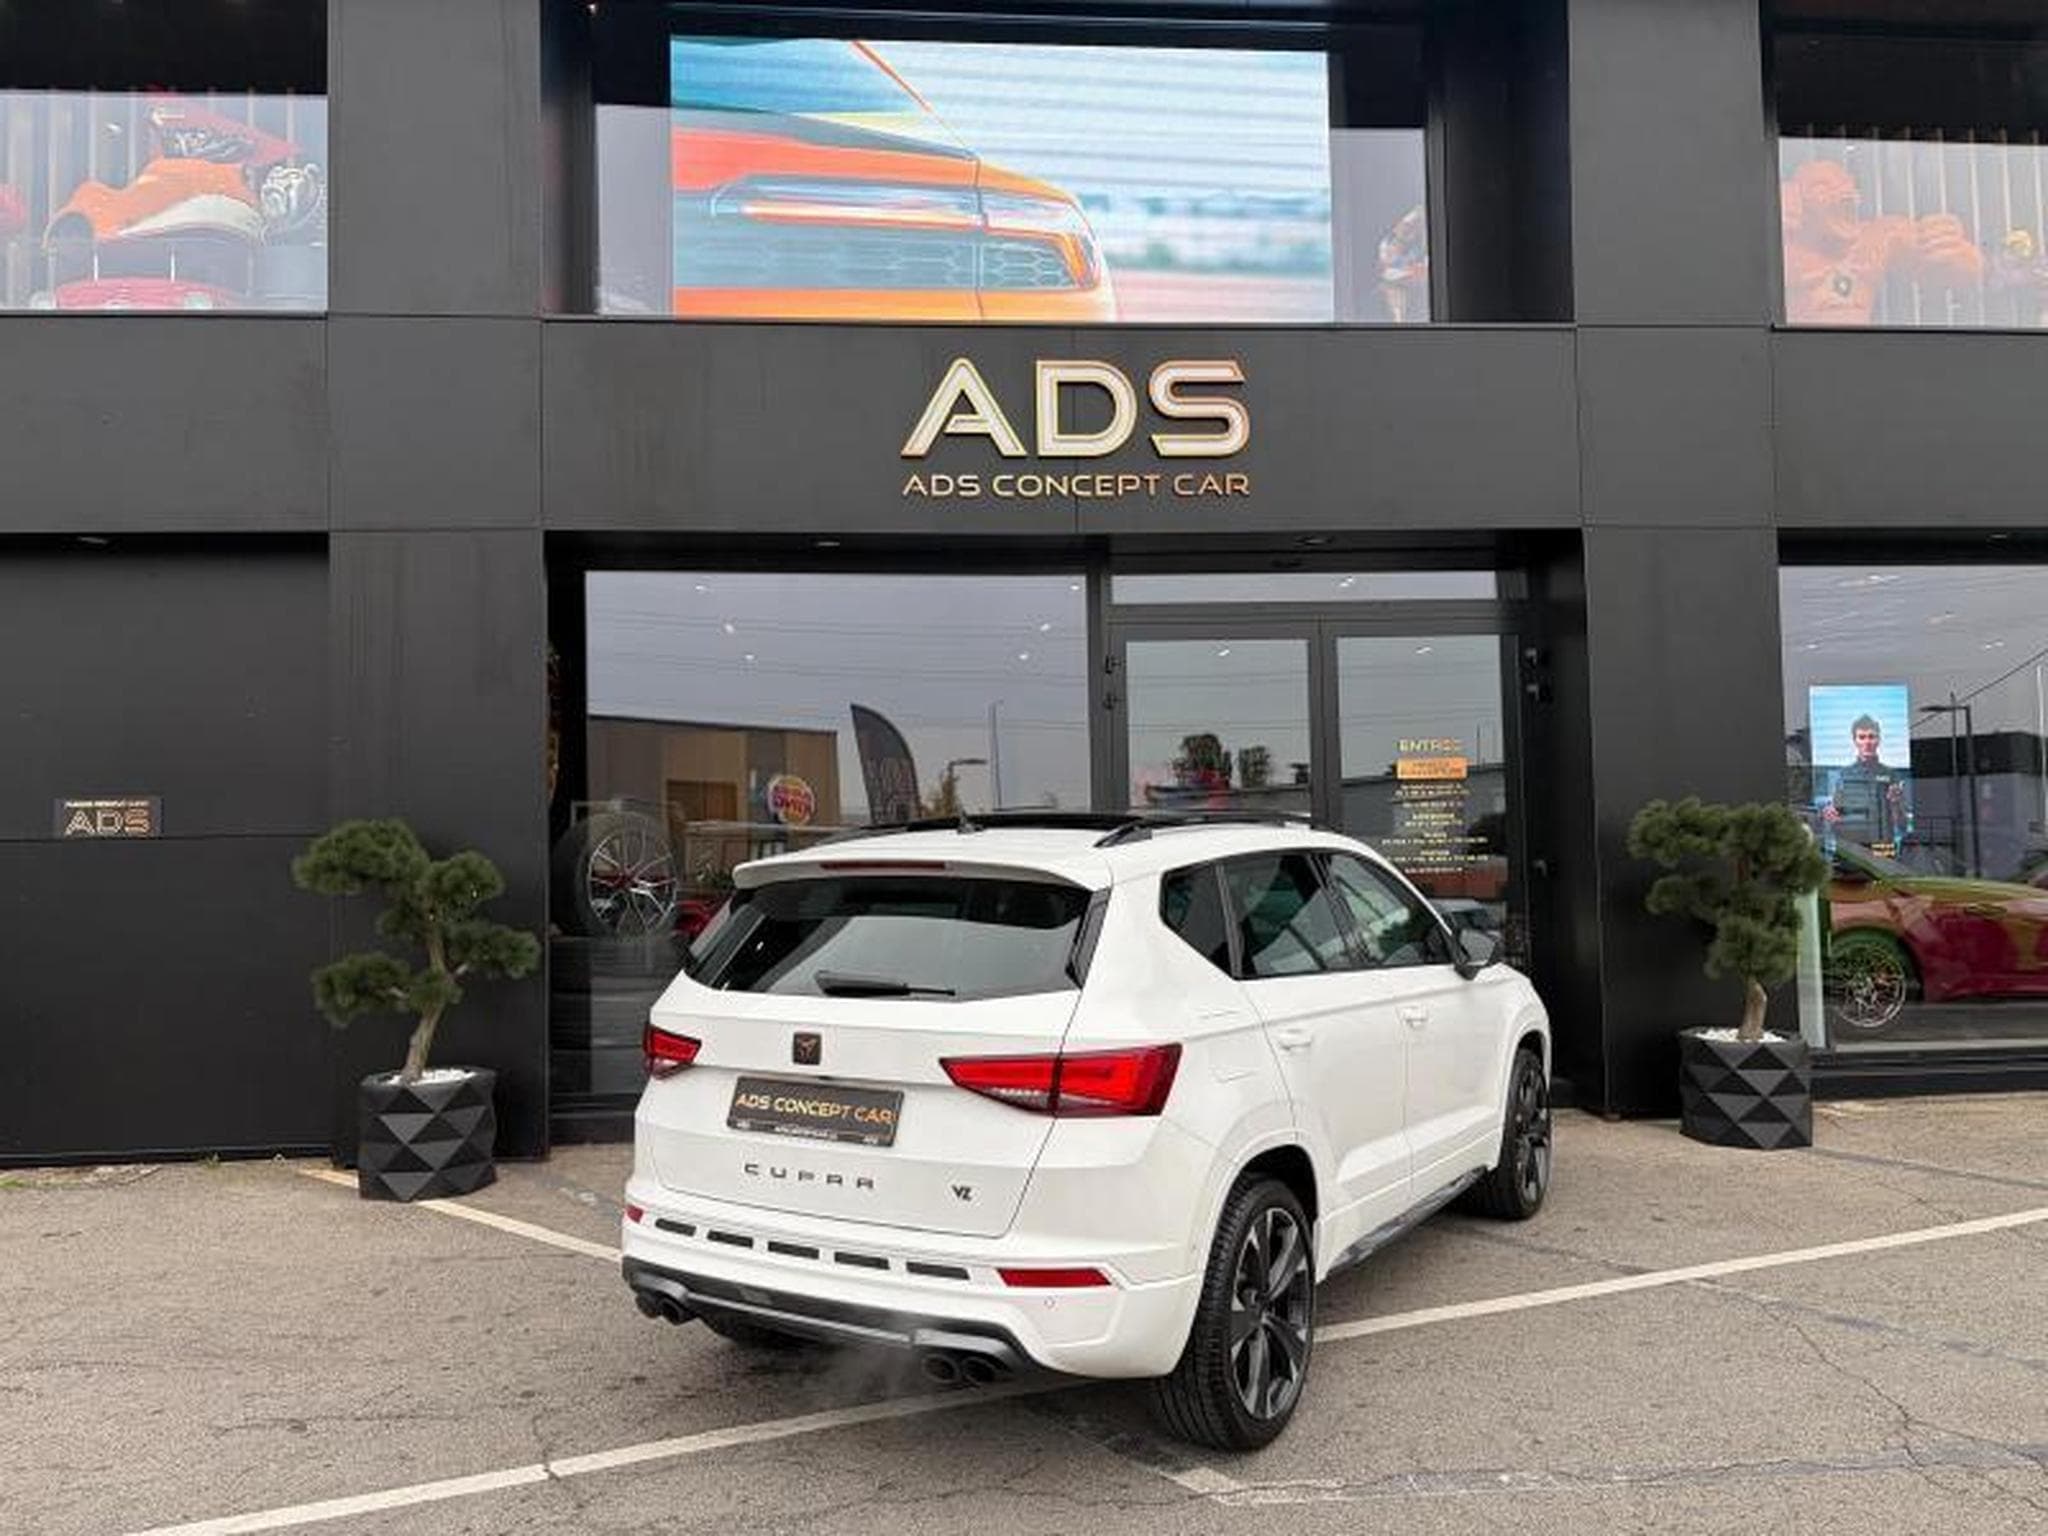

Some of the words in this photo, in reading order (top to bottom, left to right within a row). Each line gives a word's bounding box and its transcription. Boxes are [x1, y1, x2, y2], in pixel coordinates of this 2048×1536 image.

[901, 357, 1251, 459] ADS
[902, 475, 981, 497] ADS
[993, 475, 1162, 497] CONCEPT
[1173, 474, 1251, 497] CAR
[64, 809, 151, 836] ADS
[734, 1093, 771, 1111] ADS
[773, 1097, 852, 1120] CONCEPT
[853, 1107, 894, 1124] CAR
[744, 1163, 875, 1190] CUPRA
[951, 1184, 973, 1202] VZ
